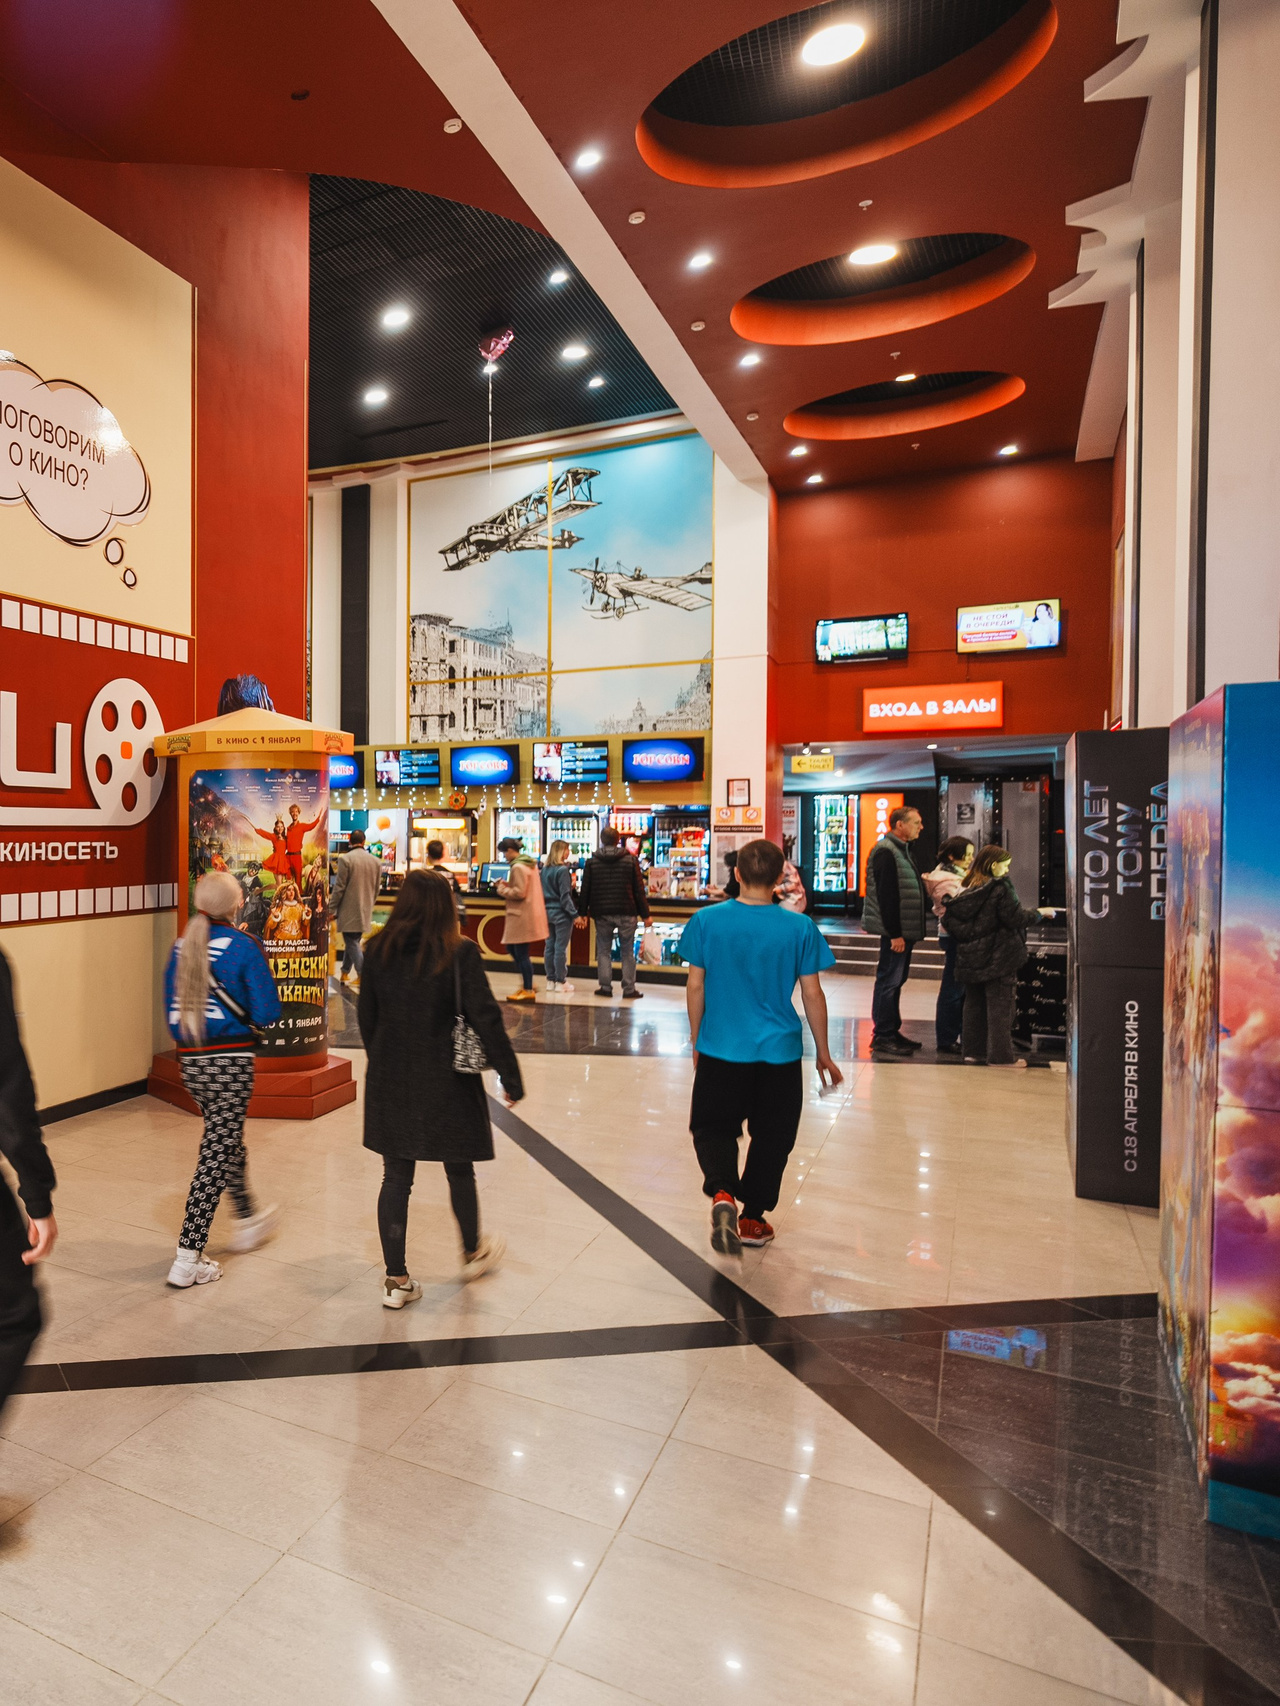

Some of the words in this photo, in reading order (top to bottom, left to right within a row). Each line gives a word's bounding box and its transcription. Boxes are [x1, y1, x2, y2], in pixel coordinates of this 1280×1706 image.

[8, 441, 23, 467] О
[28, 449, 90, 492] КИНО?
[869, 701, 923, 718] ВХОД
[925, 700, 939, 716] В
[942, 697, 997, 715] ЗАЛЫ
[226, 737, 250, 745] КИНО
[260, 736, 266, 744] 1
[268, 736, 302, 745] ЯНВАРЯ
[961, 805, 971, 818] 3
[1083, 779, 1110, 844] ЛЕТ
[1116, 802, 1143, 896] ТОМУ
[1083, 850, 1110, 920] СТО
[285, 938, 310, 946] РАДОСТЬ
[288, 1019, 294, 1029] 1
[296, 1016, 322, 1028] ЯНВАРЯ
[1124, 1000, 1140, 1048] КИНО
[1124, 1050, 1139, 1063] В
[1124, 1065, 1138, 1133] АПРЕЛЯ
[1124, 1135, 1138, 1157] 18
[1124, 1159, 1138, 1172] С
